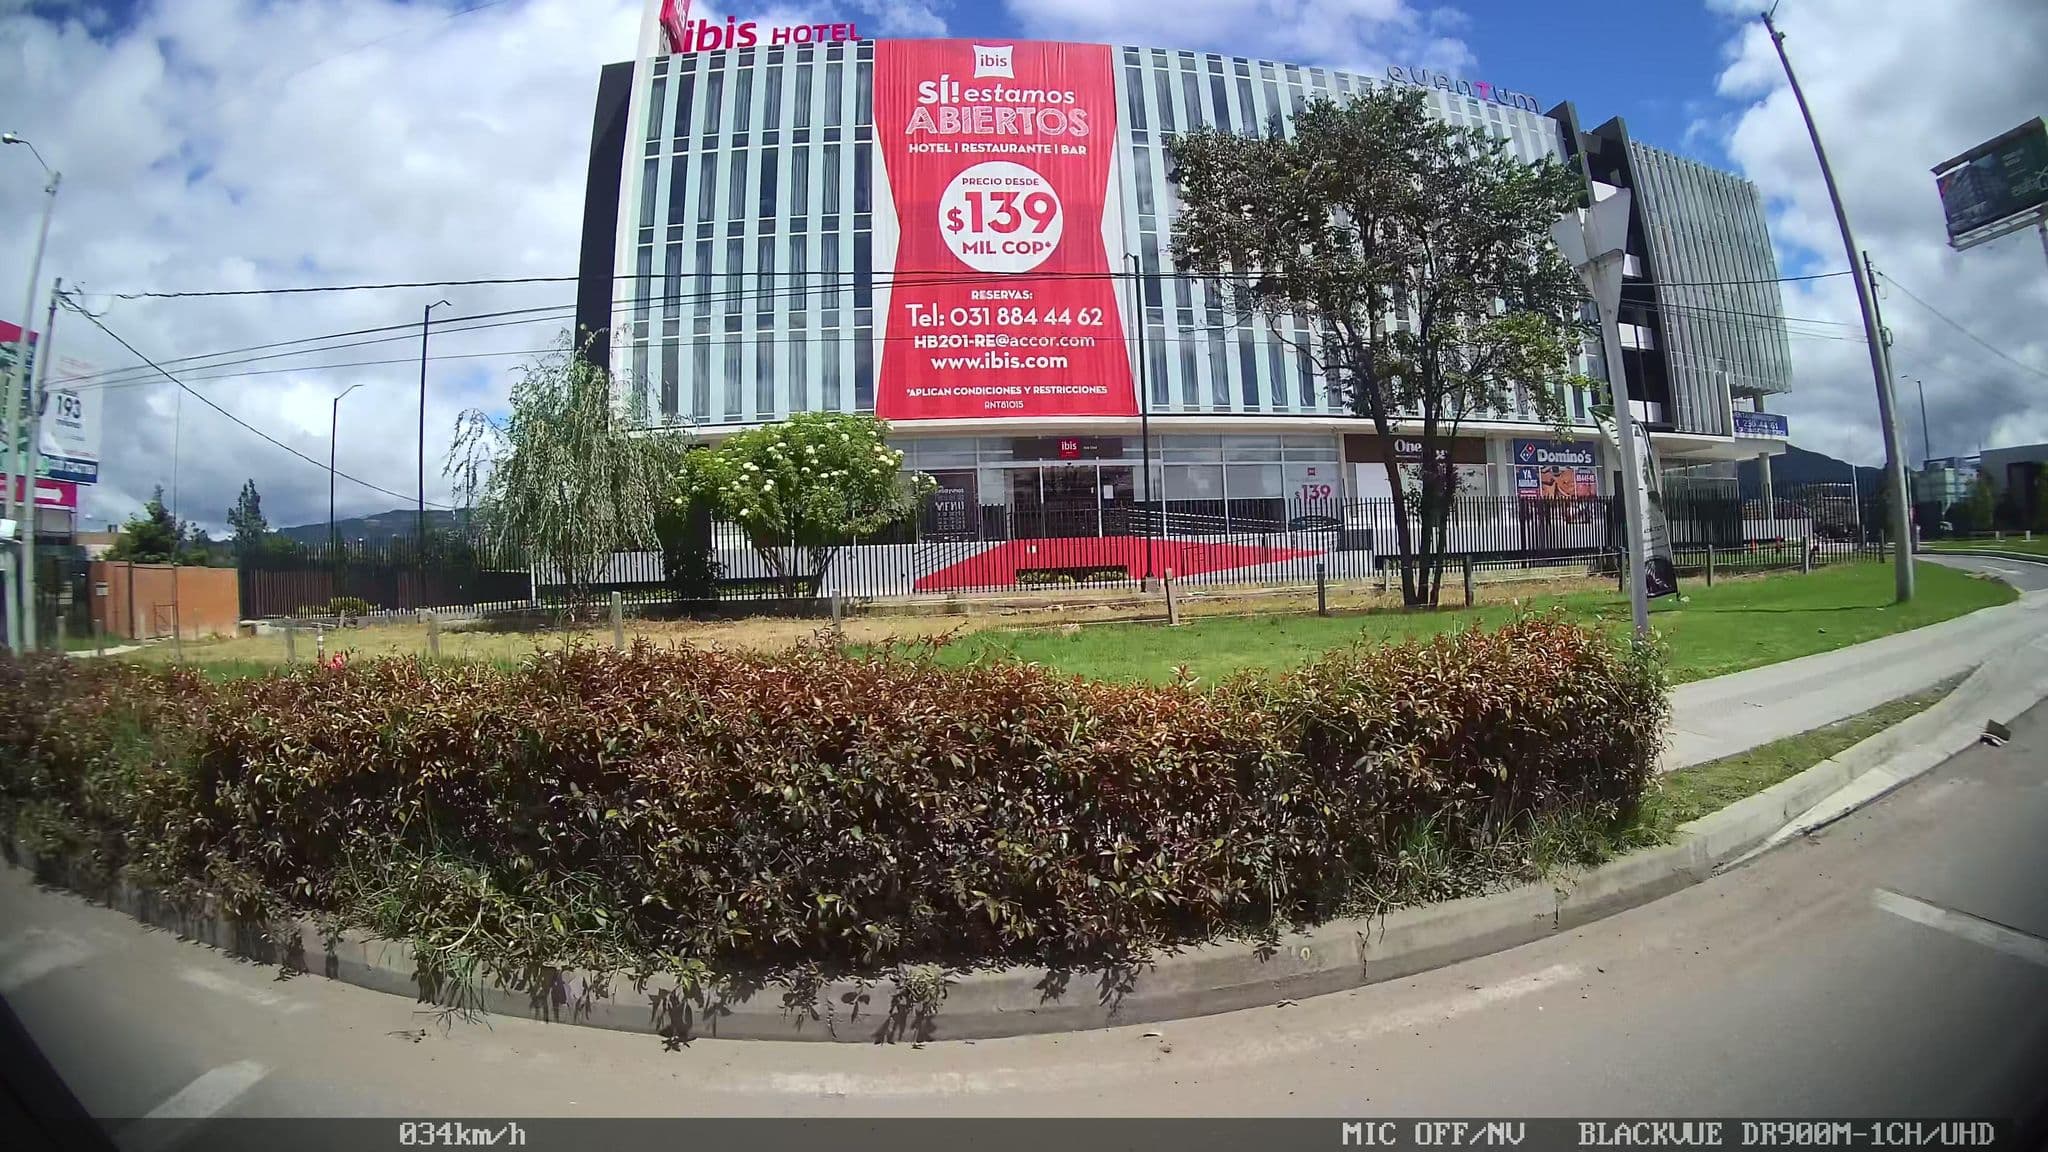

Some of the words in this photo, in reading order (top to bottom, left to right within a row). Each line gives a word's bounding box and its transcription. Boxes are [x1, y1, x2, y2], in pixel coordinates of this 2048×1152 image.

[684, 16, 757, 52] ibis
[772, 23, 863, 45] HOTEL
[980, 54, 1008, 67] ibis
[918, 74, 960, 104] SÍ!
[964, 84, 1075, 103] estamos
[905, 106, 1090, 136] ABIERTOS
[909, 143, 952, 153] HOTEL
[961, 143, 1052, 154] RESTAURANTE
[1061, 144, 1087, 155] BAR
[962, 177, 1002, 186] PRECIO
[1005, 177, 1039, 186] DESDE
[962, 240, 997, 254] MIL
[971, 290, 1033, 300] RESERVAS:
[905, 303, 945, 327] Tel:
[950, 307, 990, 326] 031
[996, 307, 1038, 326] 884
[1043, 307, 1072, 326] 44
[1077, 307, 1104, 326] 62
[930, 351, 1068, 370] www.ibis.com
[953, 386, 1022, 396] CONDICIONES
[1024, 386, 1031, 395] Y
[1033, 385, 1108, 395] RESTRICCIONES
[1061, 440, 1077, 450] ibis
[1537, 449, 1592, 464] Domino's
